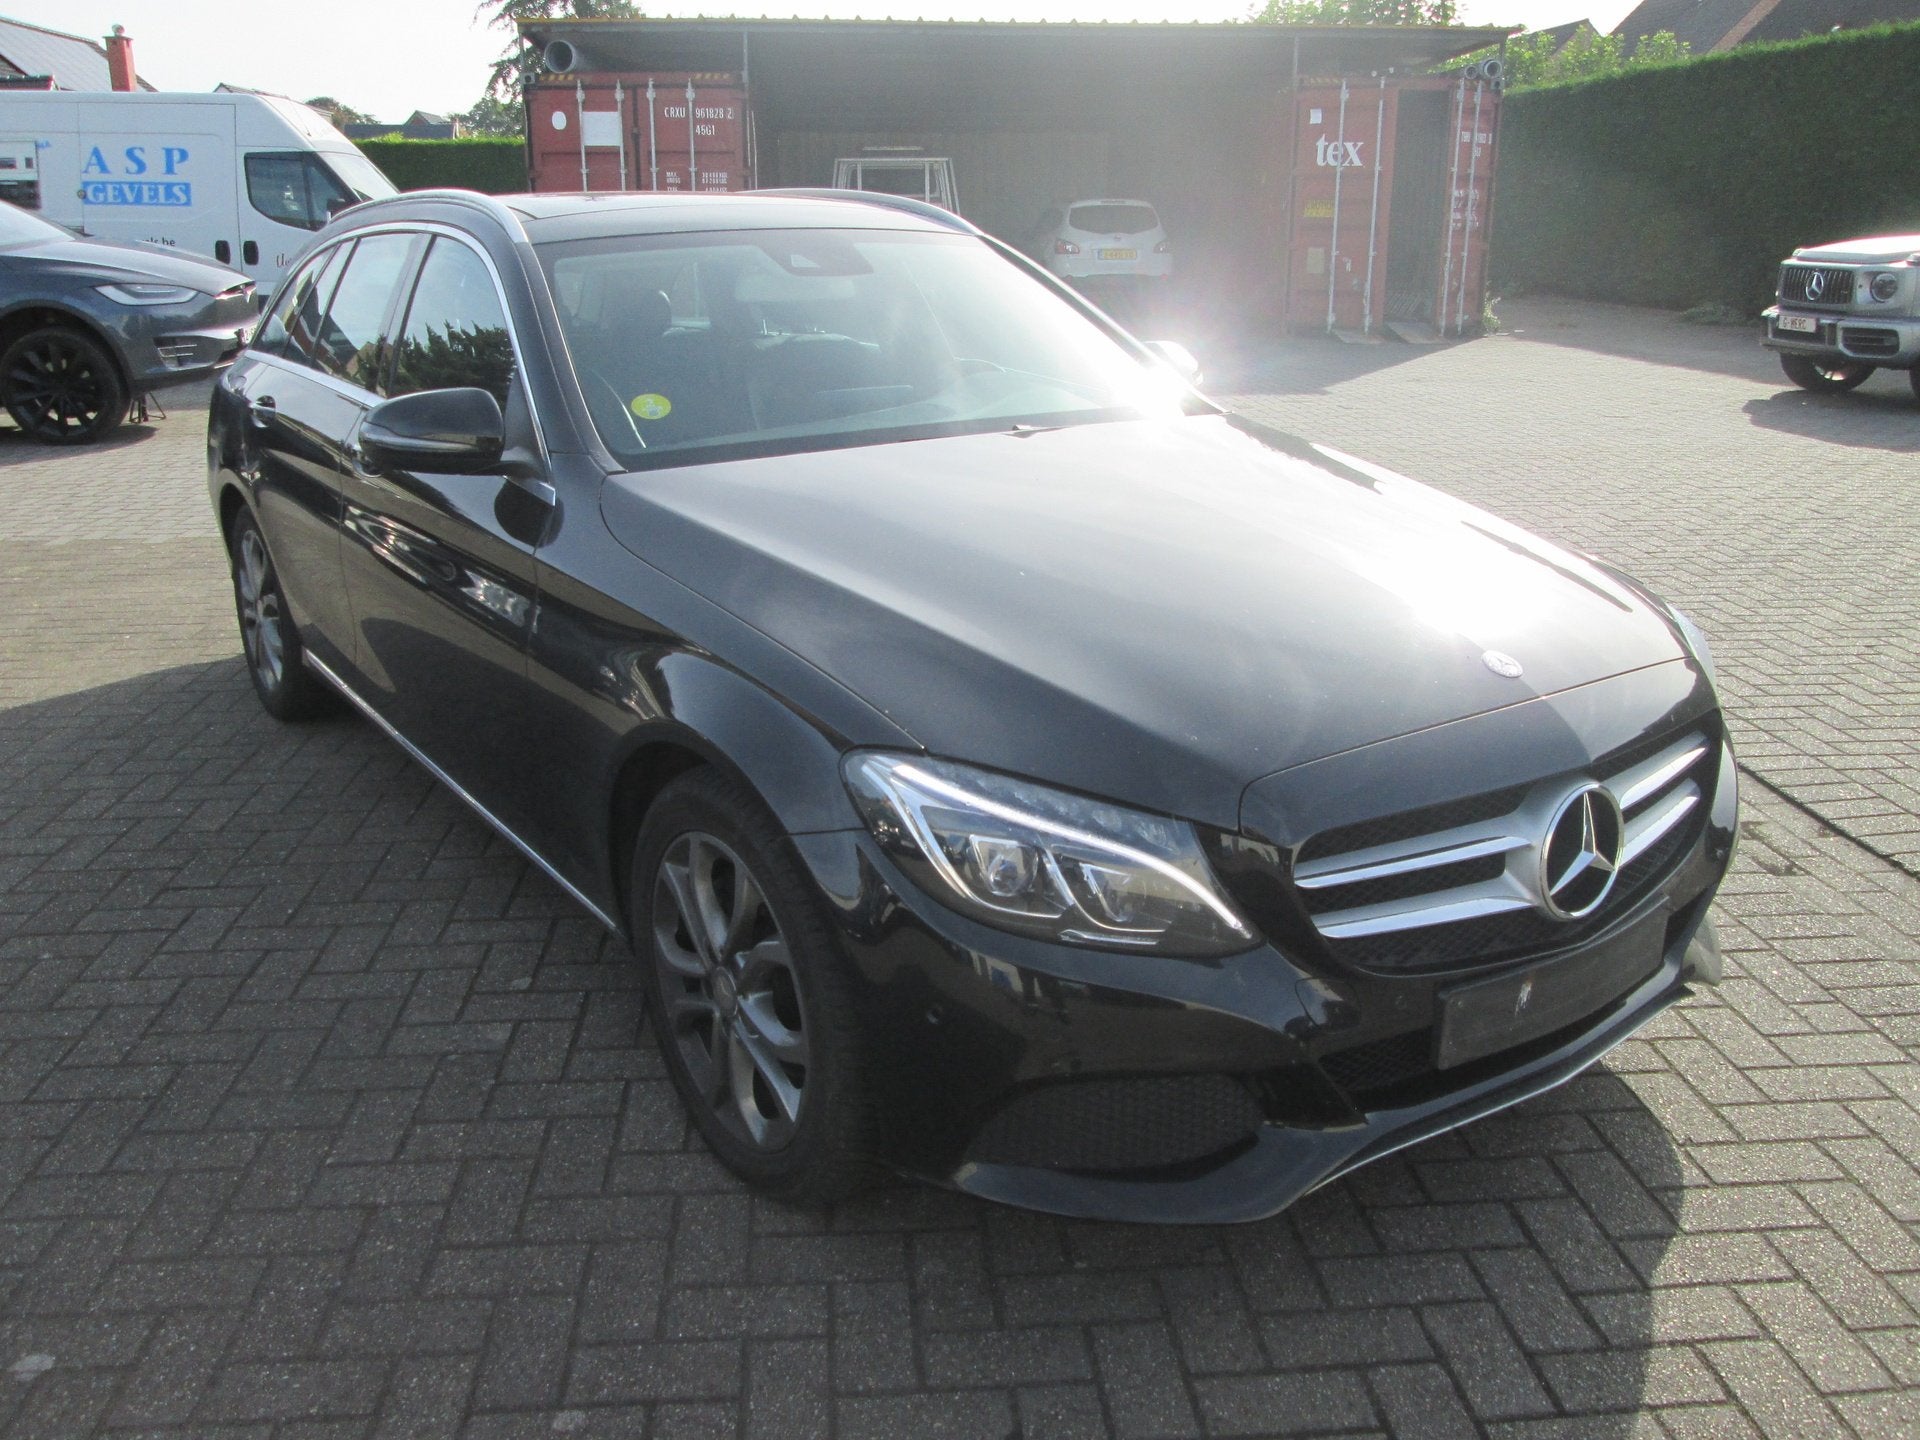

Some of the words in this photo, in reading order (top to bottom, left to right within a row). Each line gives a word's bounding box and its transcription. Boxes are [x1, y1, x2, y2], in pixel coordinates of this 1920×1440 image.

[664, 107, 686, 118] CRXU
[695, 107, 724, 119] 961828
[695, 124, 715, 136] 45G1
[1315, 133, 1364, 168] tex
[85, 183, 187, 205] GEVELS
